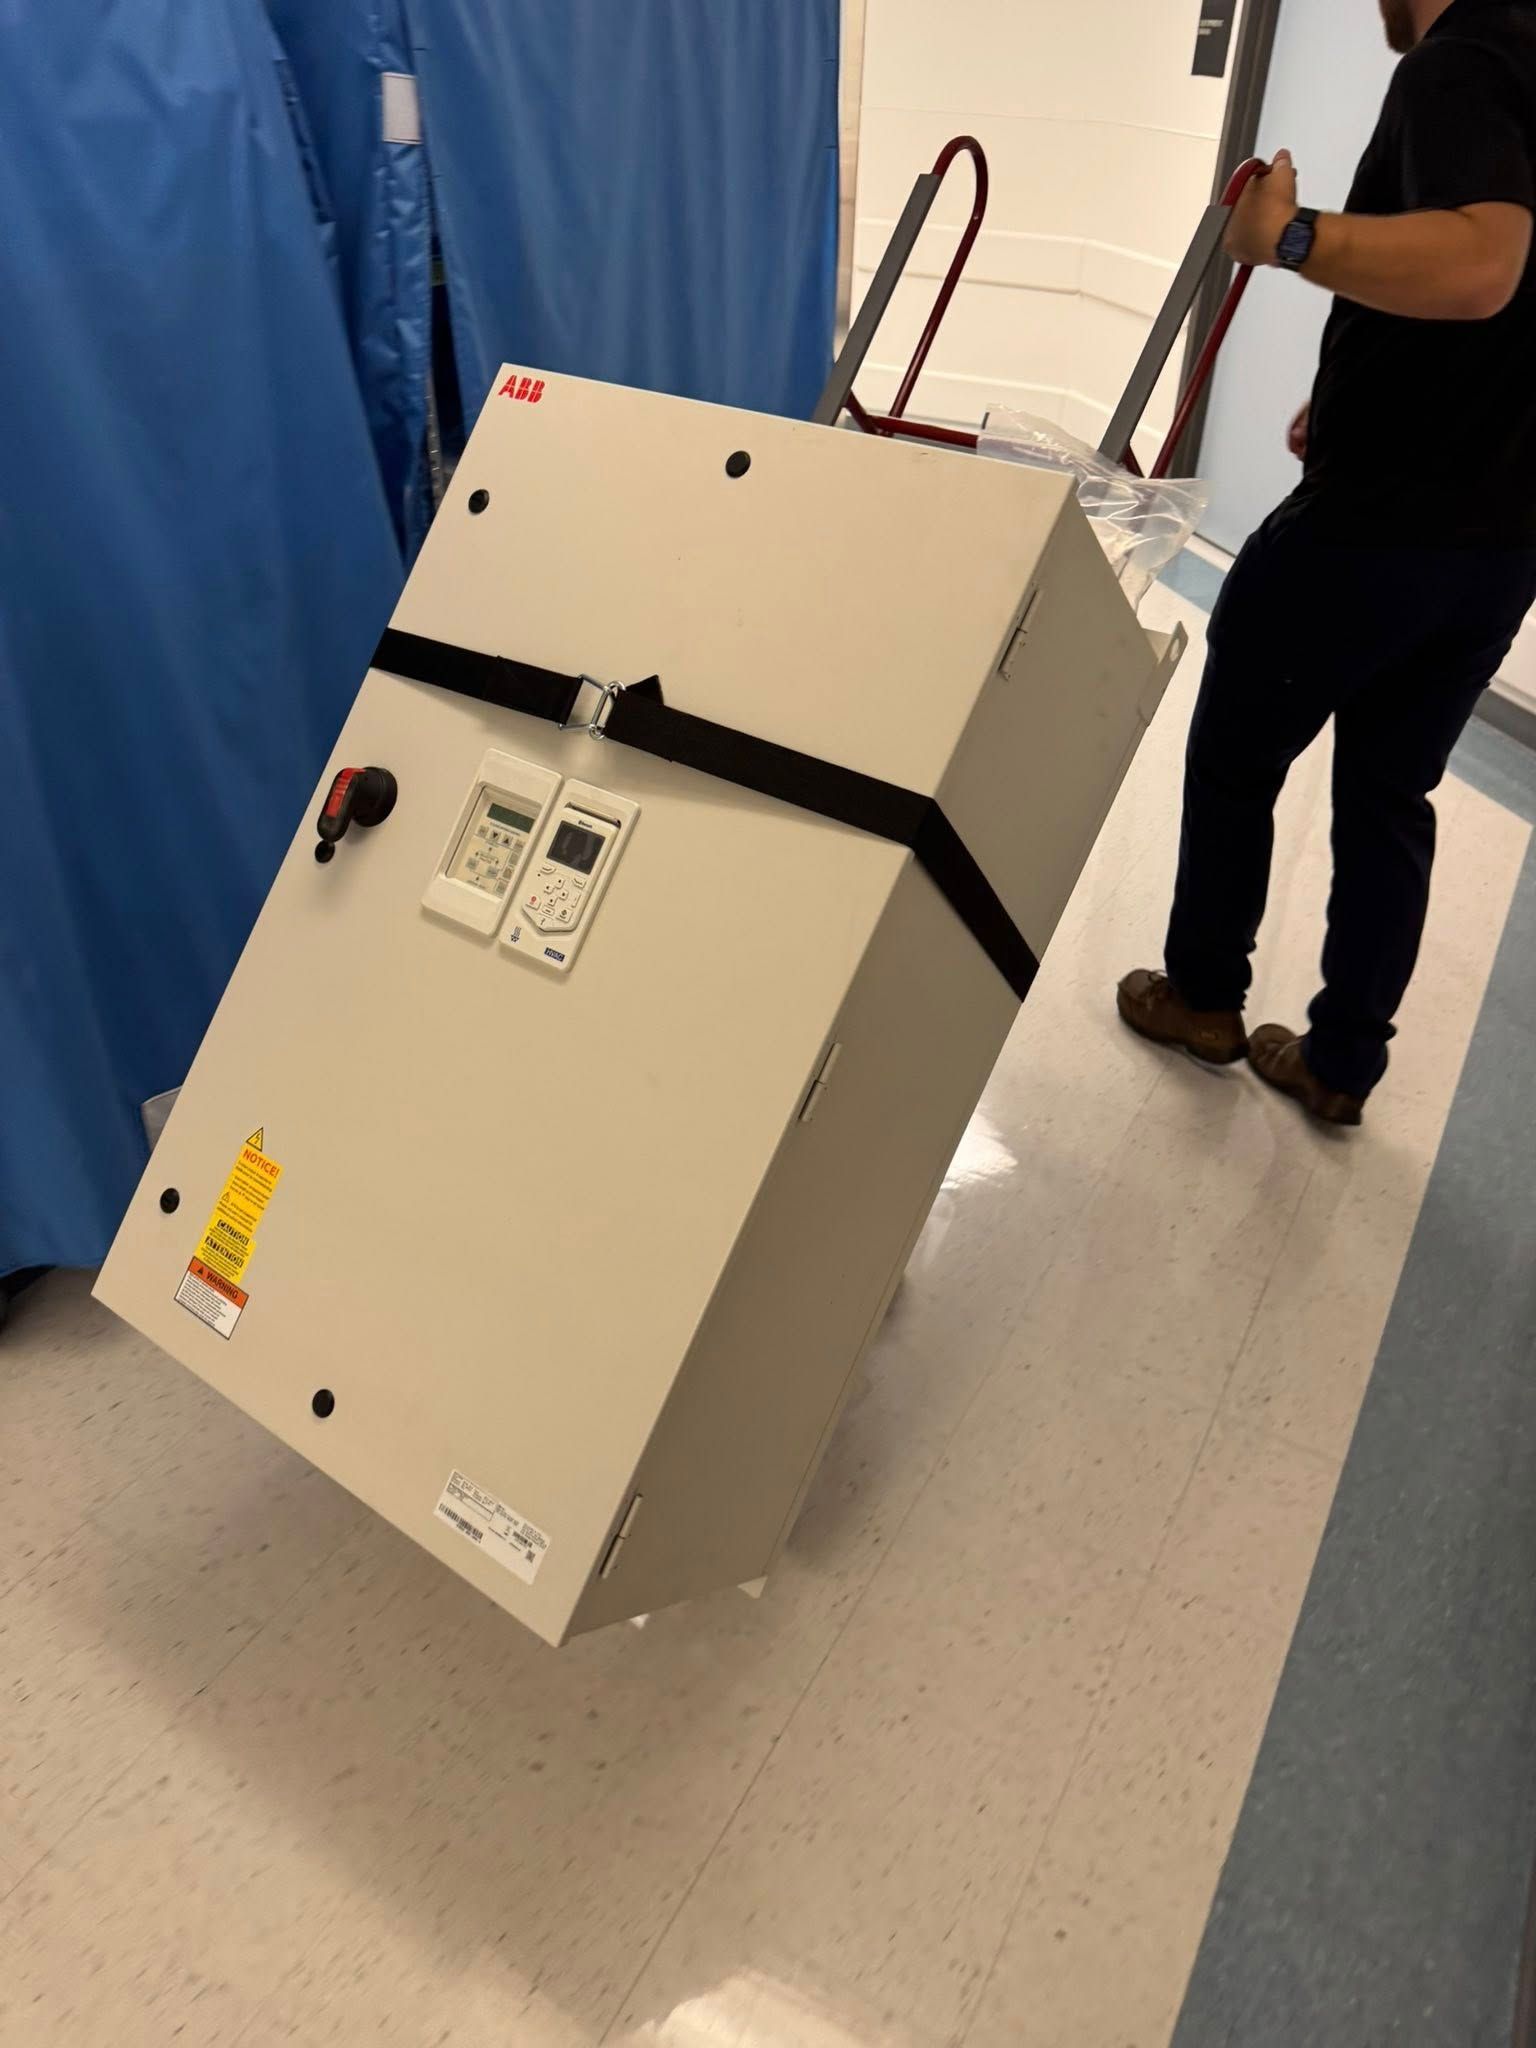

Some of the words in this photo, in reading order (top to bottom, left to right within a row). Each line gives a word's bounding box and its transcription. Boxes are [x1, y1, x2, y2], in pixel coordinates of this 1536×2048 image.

[498, 375, 545, 403] ABB
[242, 1149, 280, 1178] NOTICE!
[206, 1271, 239, 1299] WARNING
